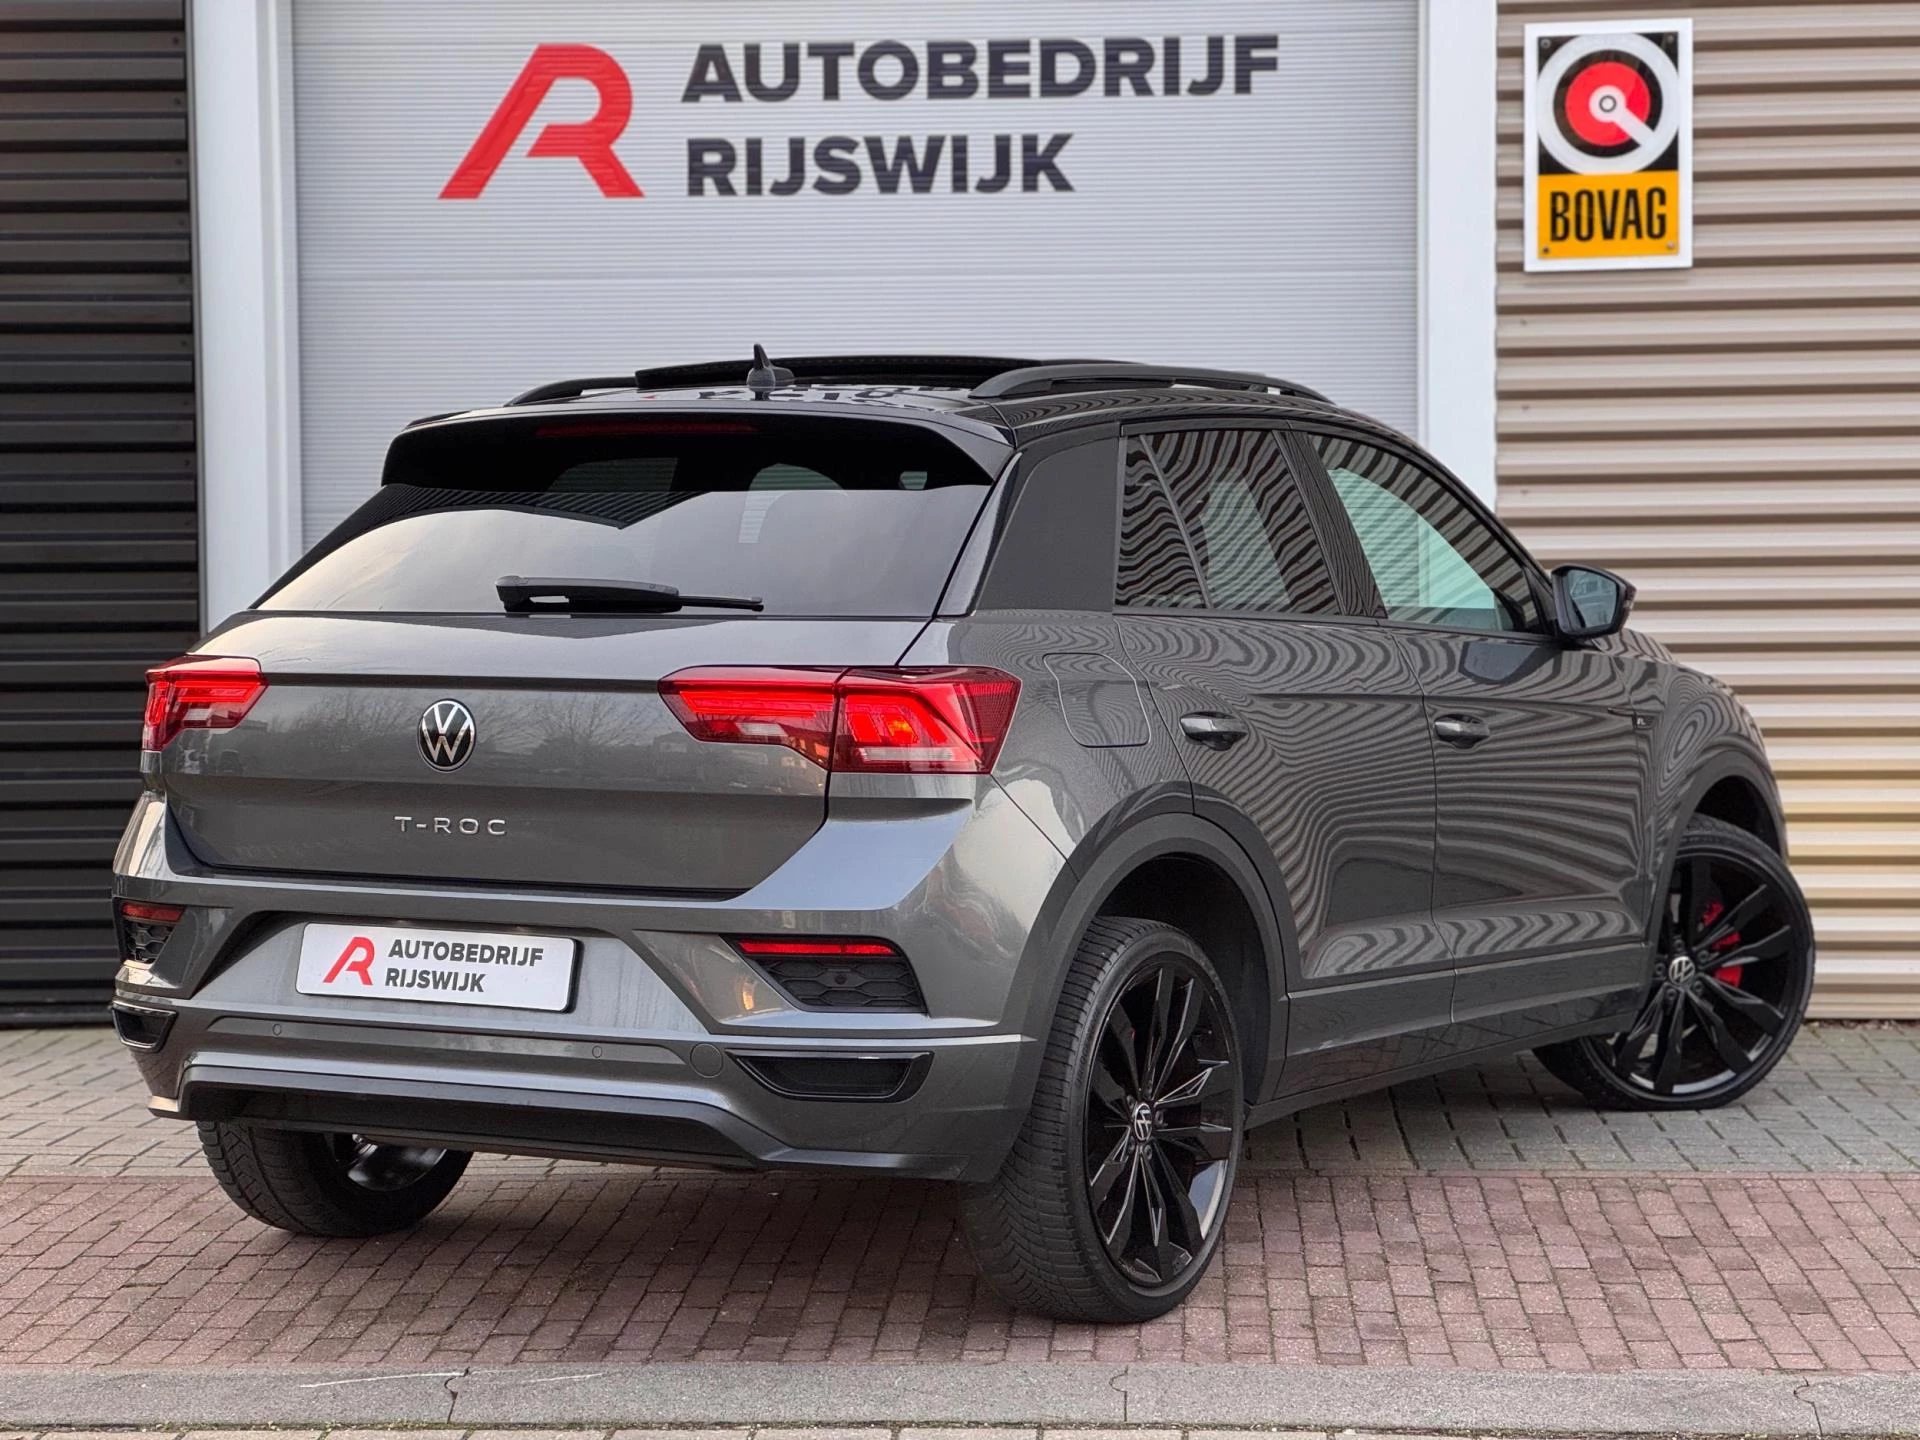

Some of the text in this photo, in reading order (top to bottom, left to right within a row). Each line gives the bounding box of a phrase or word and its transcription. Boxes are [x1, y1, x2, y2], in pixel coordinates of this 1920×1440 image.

[683, 34, 1279, 103] AUTOBEDRIJF
[687, 133, 1075, 197] RIJSWIJK
[1550, 187, 1667, 242] BOVAG
[394, 815, 506, 836] T-ROC
[388, 938, 544, 967] AUTOBEDRIJF
[384, 967, 486, 993] RIJSWIJK
